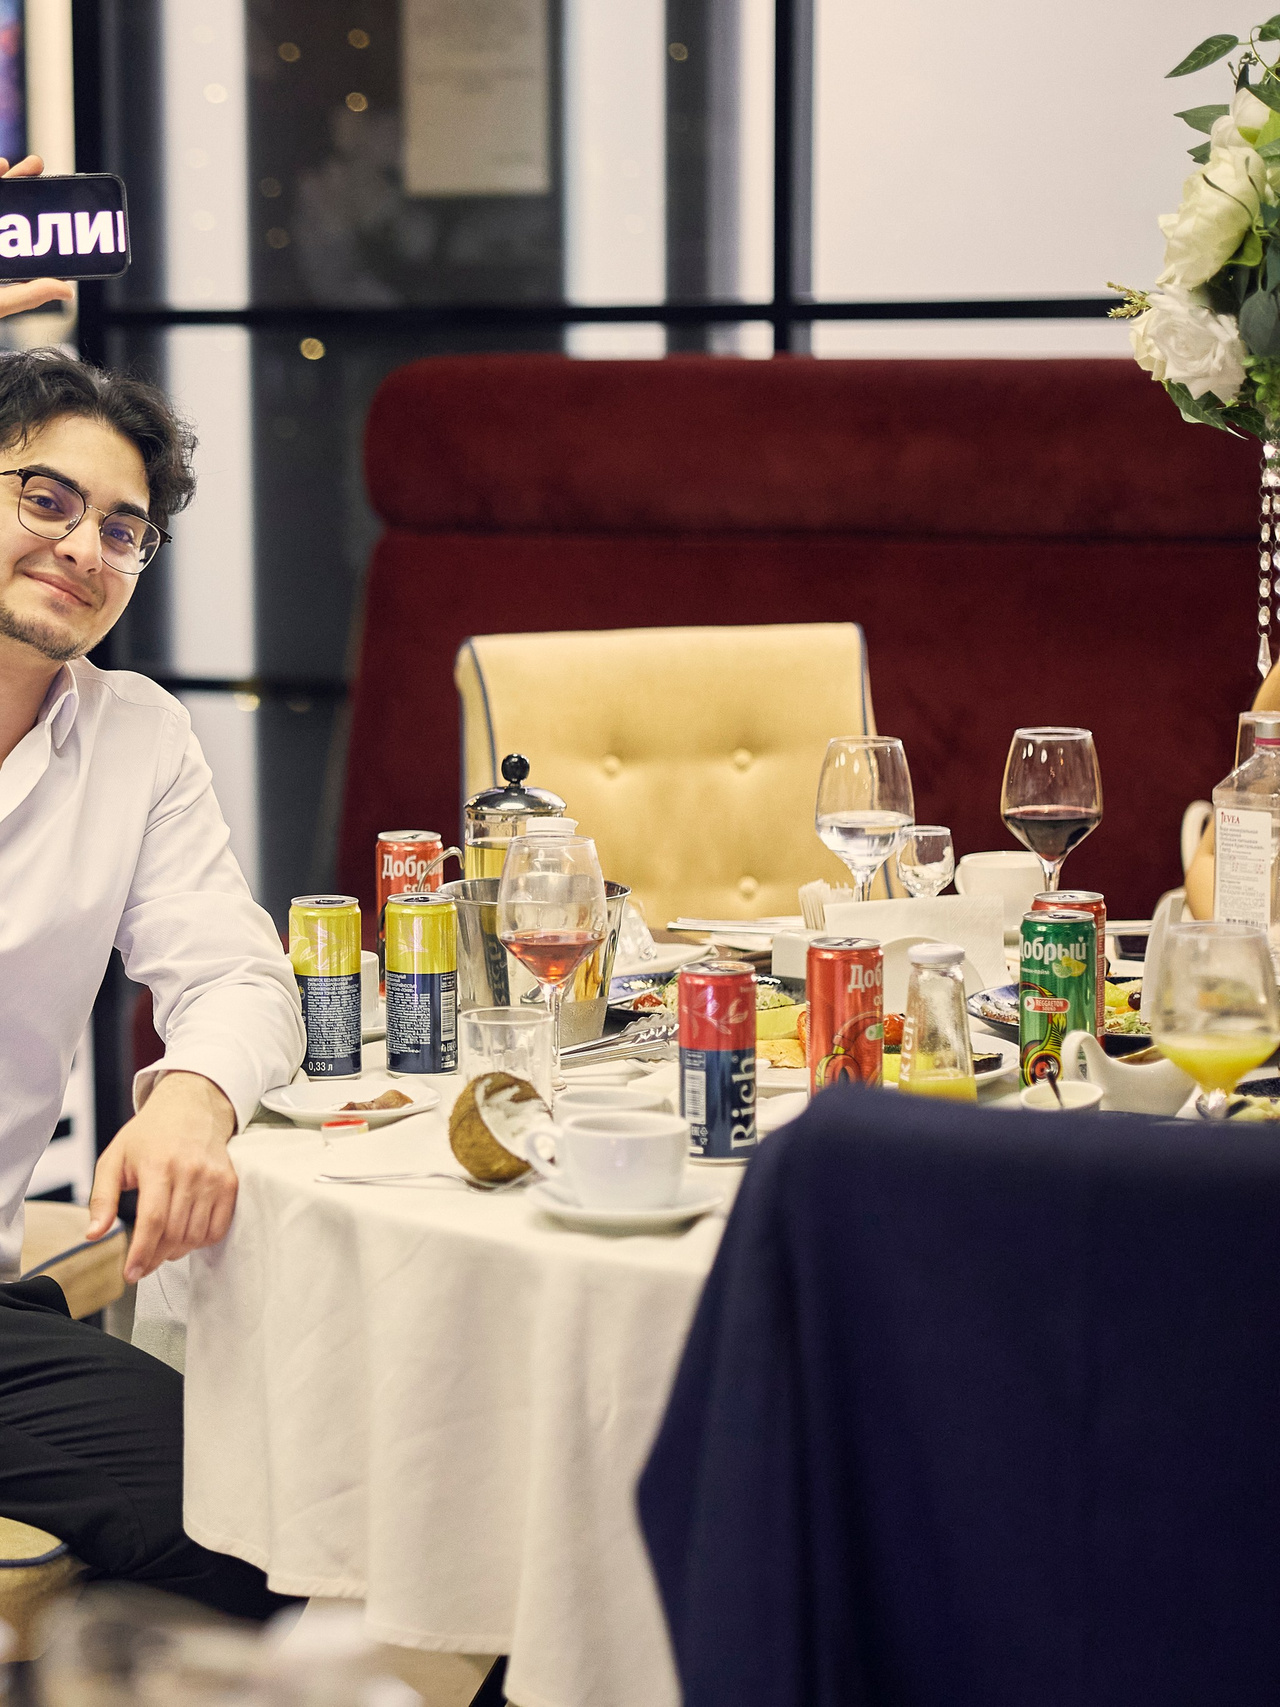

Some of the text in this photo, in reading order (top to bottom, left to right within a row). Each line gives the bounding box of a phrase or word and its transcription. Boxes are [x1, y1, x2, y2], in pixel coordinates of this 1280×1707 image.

[381, 853, 442, 881] Добр
[847, 962, 883, 994] Доб
[308, 1061, 333, 1072] 0,33 л
[730, 1056, 757, 1150] Rich
